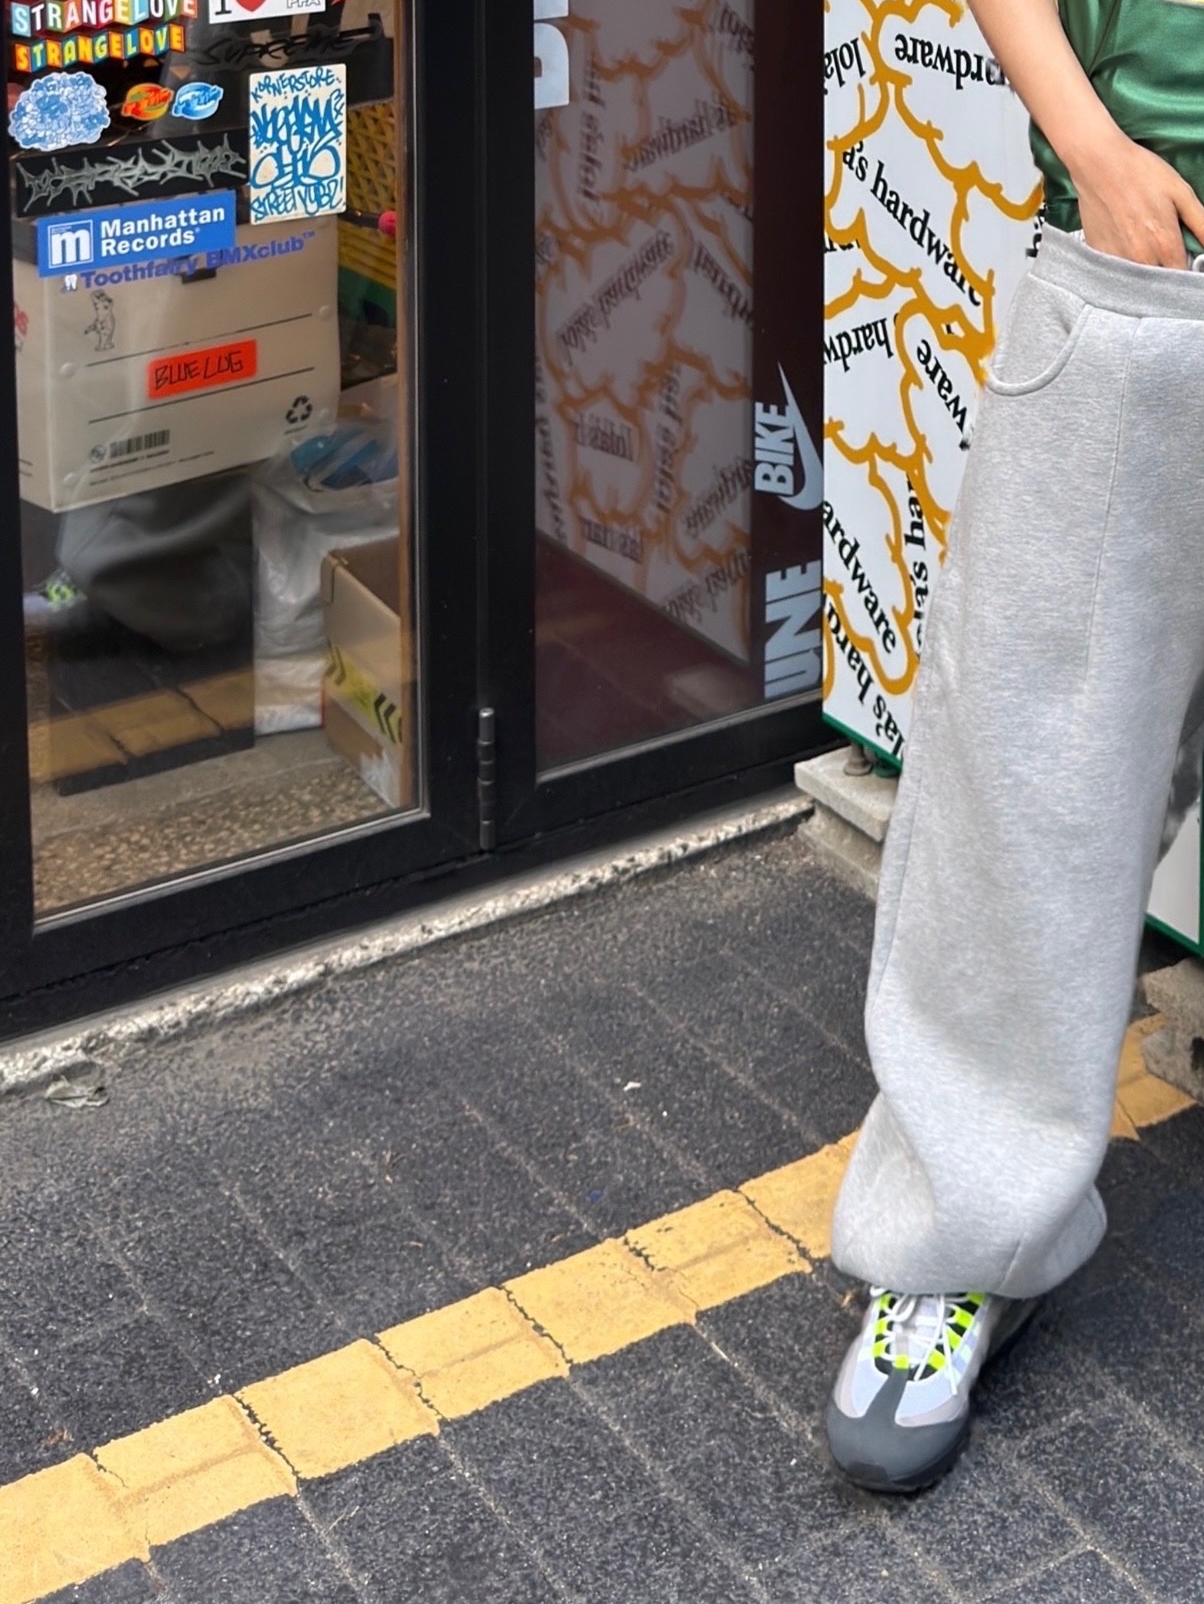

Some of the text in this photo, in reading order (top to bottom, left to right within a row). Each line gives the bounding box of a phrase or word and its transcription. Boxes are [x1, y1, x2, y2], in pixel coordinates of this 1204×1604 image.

[17, 26, 184, 70] STRANGELOVE
[824, 36, 867, 95] lola
[101, 207, 225, 238] Manhattan
[101, 228, 195, 256] Records
[80, 254, 199, 289] Toothfairy
[754, 400, 794, 497] BIKE
